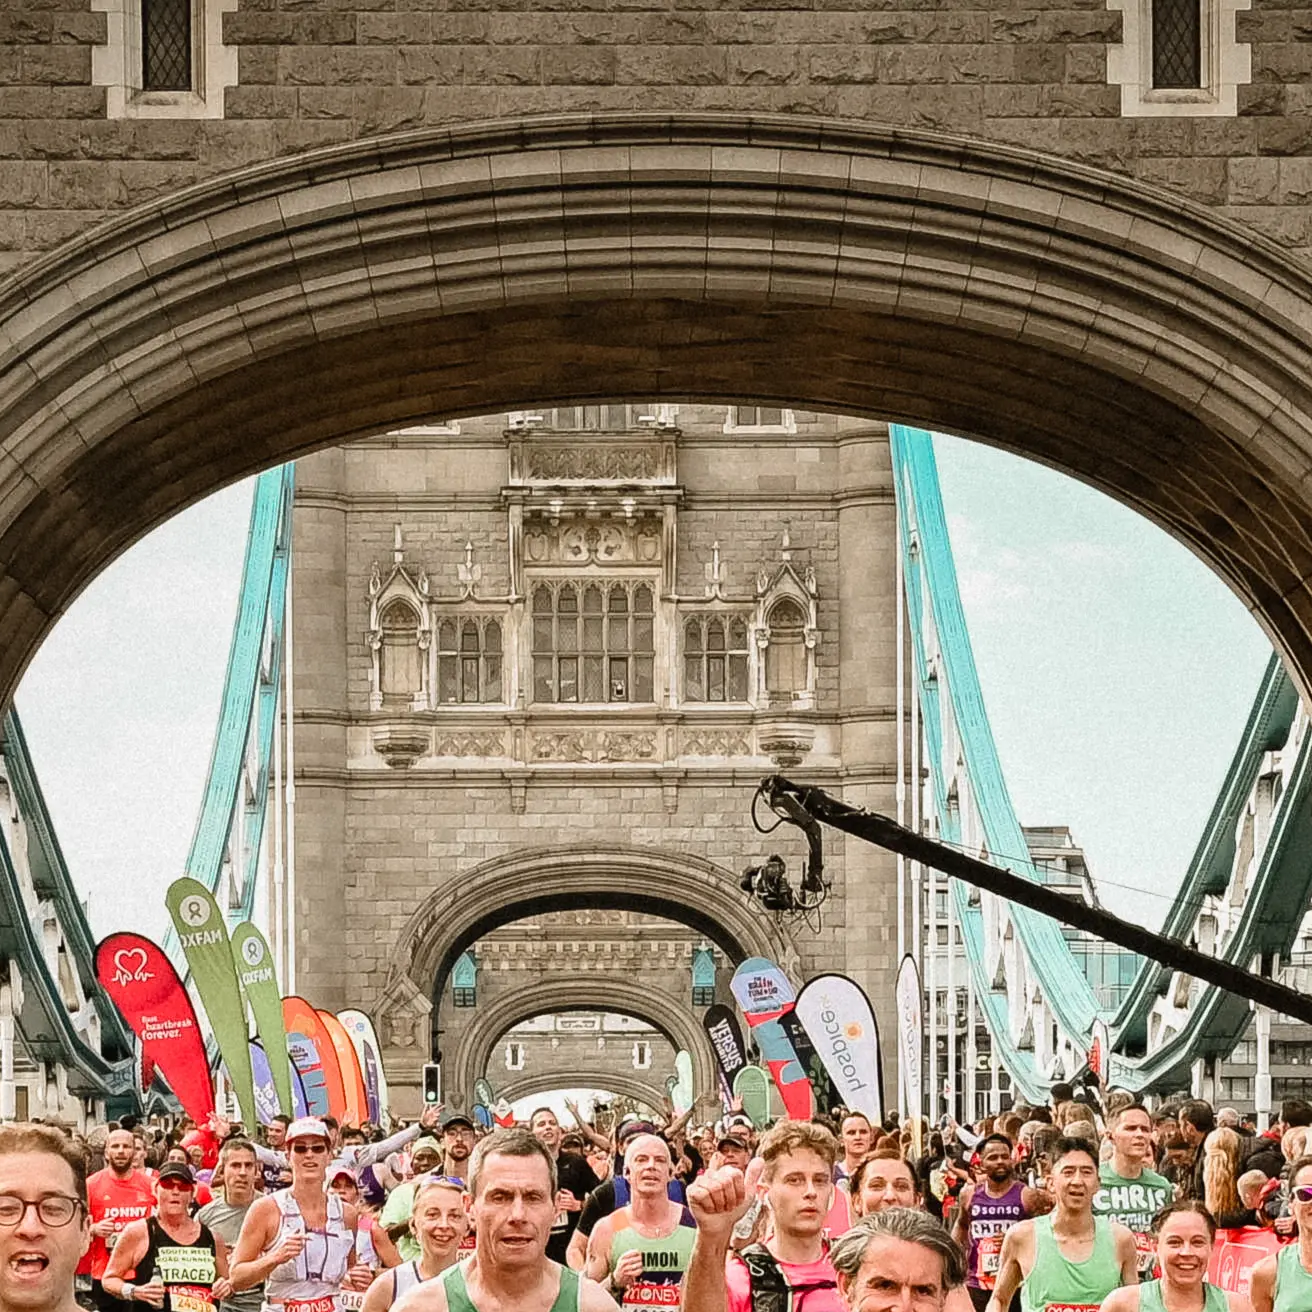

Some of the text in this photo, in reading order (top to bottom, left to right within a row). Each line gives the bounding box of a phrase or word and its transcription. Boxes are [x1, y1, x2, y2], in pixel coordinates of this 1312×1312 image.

[141, 1029, 182, 1041] forever.
[714, 1018, 743, 1069] VERSUS
[1092, 1184, 1166, 1212] CHRIS
[104, 1206, 148, 1218] JONNY
[981, 1205, 1020, 1216] sense
[641, 1251, 679, 1268] IMON
[163, 1268, 214, 1281] TRACEY
